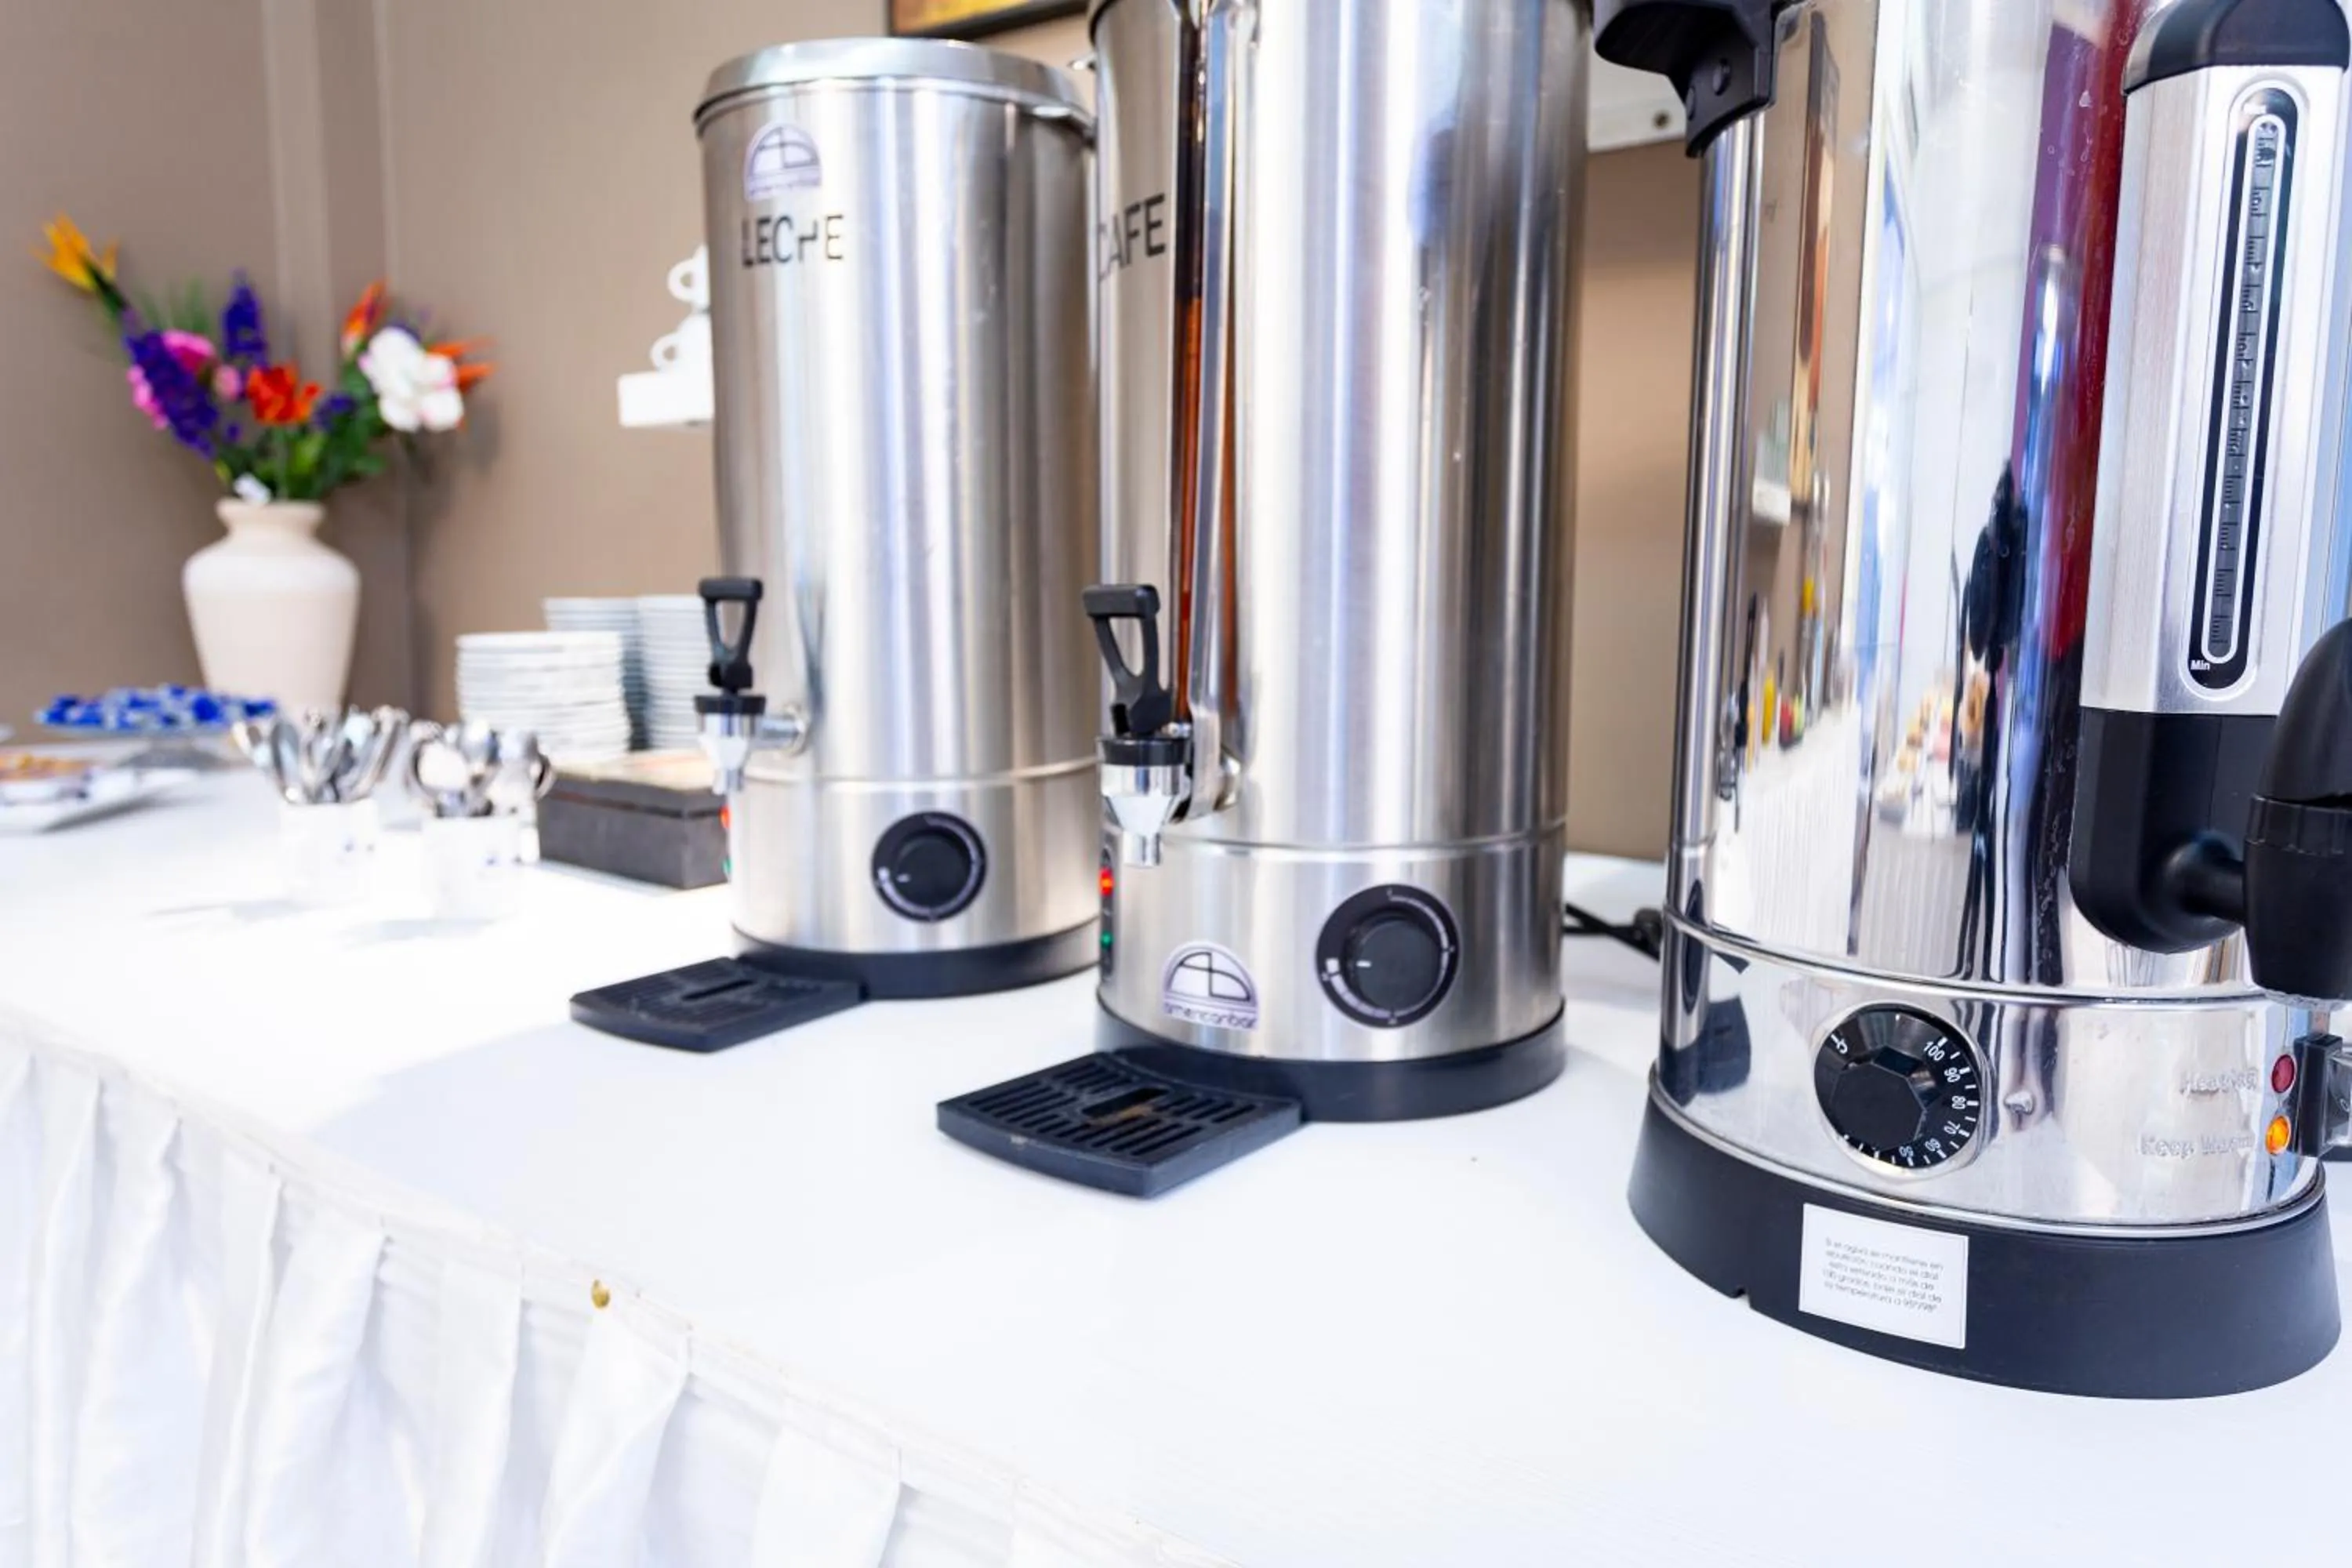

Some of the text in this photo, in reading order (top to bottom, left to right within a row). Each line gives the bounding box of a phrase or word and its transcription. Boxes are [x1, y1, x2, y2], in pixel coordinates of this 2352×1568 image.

[742, 214, 844, 269] LECHE
[2190, 660, 2210, 670] Min
[1923, 1042, 1945, 1061] 100
[1944, 1068, 1961, 1083] 90
[1951, 1095, 1966, 1109] 80
[1944, 1120, 1961, 1134] 70
